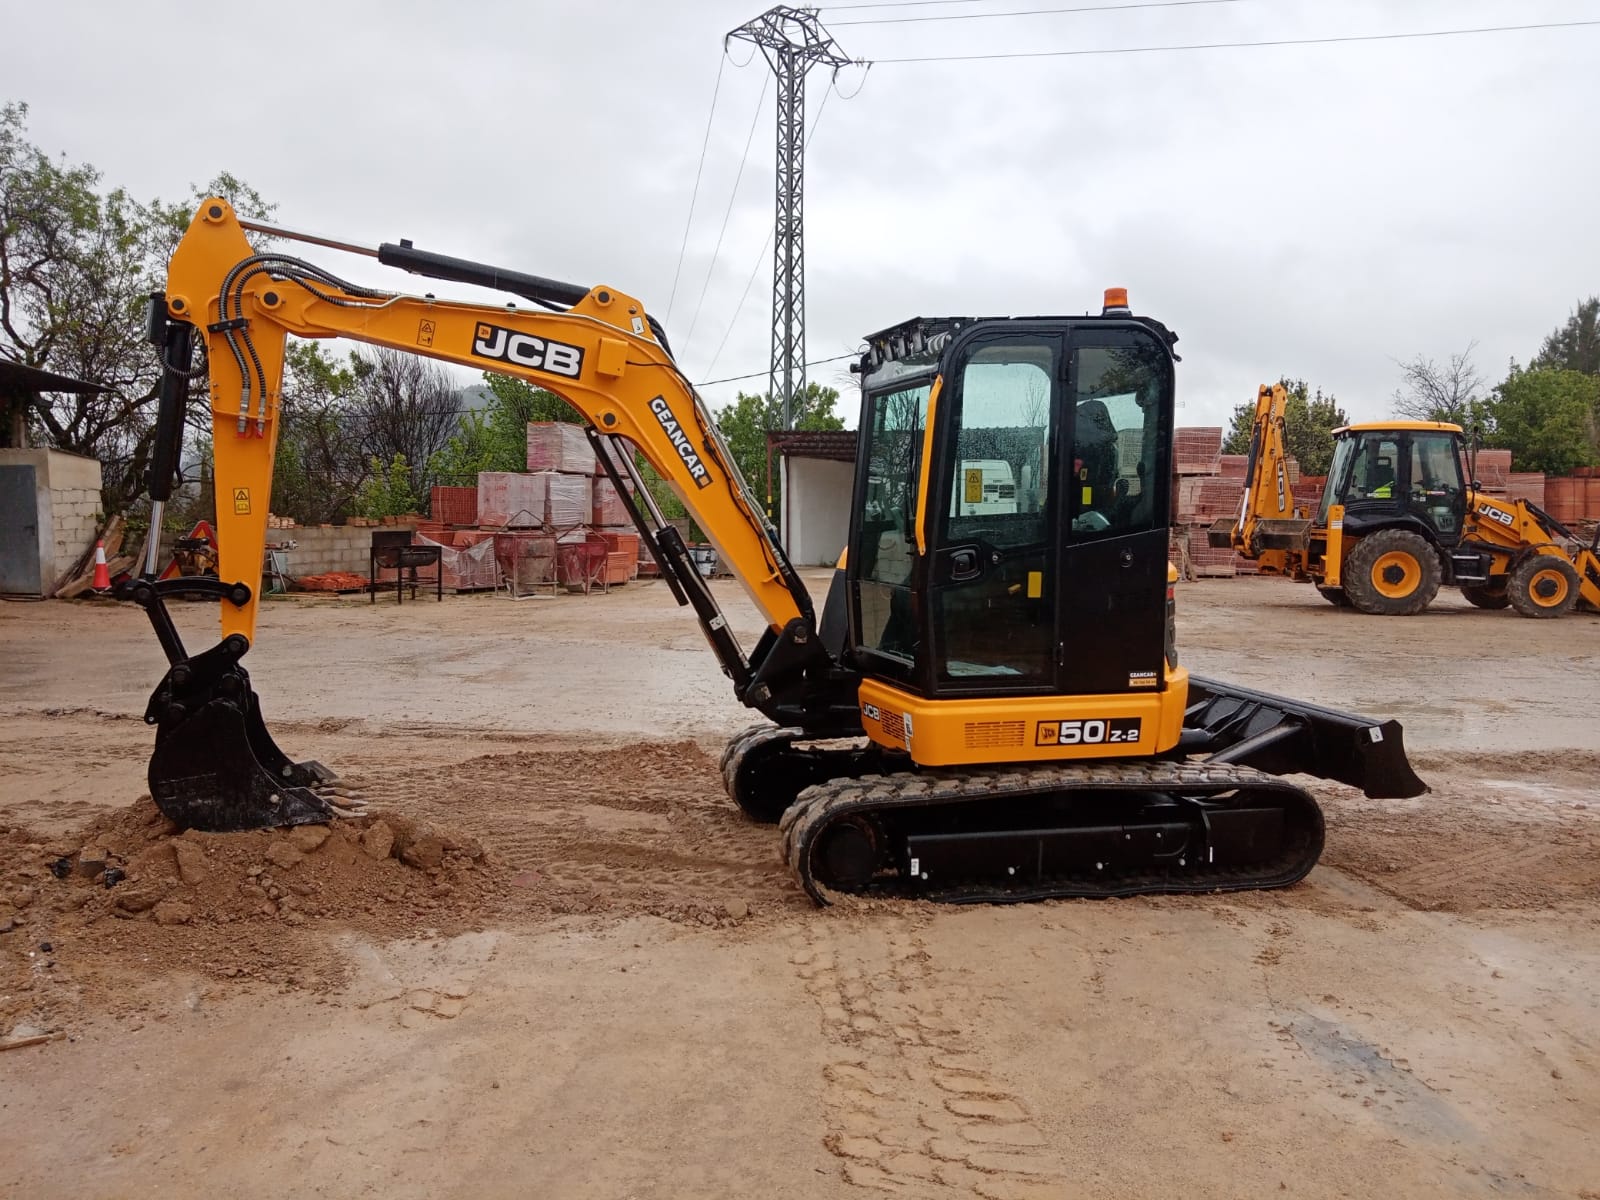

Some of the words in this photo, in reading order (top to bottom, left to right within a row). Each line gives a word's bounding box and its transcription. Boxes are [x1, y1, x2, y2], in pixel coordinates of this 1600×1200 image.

[475, 329, 581, 376] JCB
[651, 398, 705, 479] GEANCAR
[1478, 505, 1513, 525] JCB
[863, 703, 880, 720] JCB
[1059, 720, 1105, 744] 50
[1109, 729, 1139, 742] Z-2
